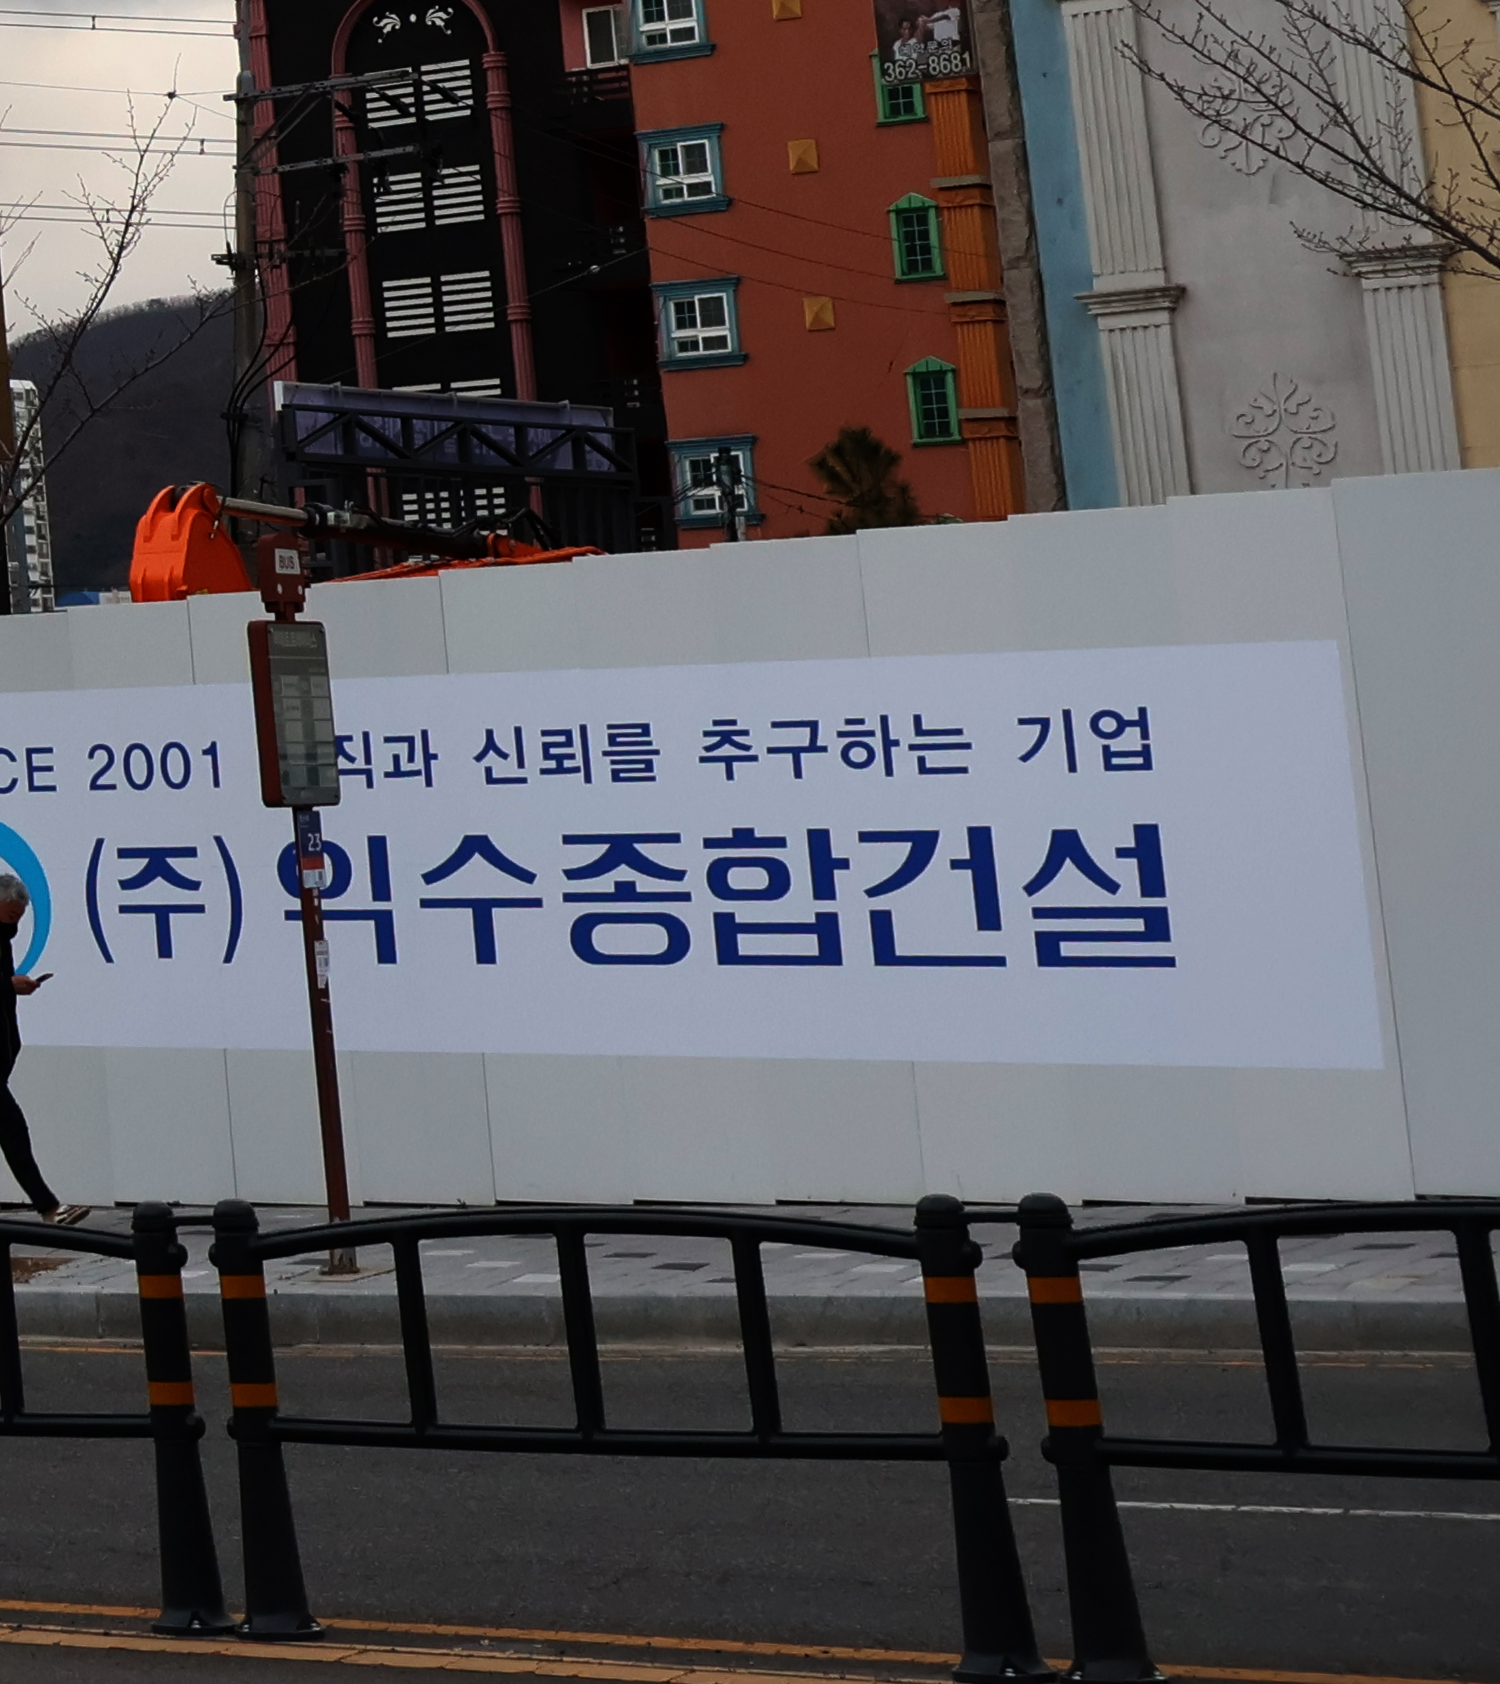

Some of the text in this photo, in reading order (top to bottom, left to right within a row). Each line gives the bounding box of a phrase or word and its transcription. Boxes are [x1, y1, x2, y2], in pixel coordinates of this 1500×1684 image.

[884, 55, 972, 82] 362-8681
[87, 740, 223, 792] 2001
[337, 729, 438, 790] 직과
[474, 723, 661, 786] 신뢰를
[699, 714, 973, 781] 추구하는
[1017, 706, 1154, 773] 기업
[308, 833, 321, 851] 23
